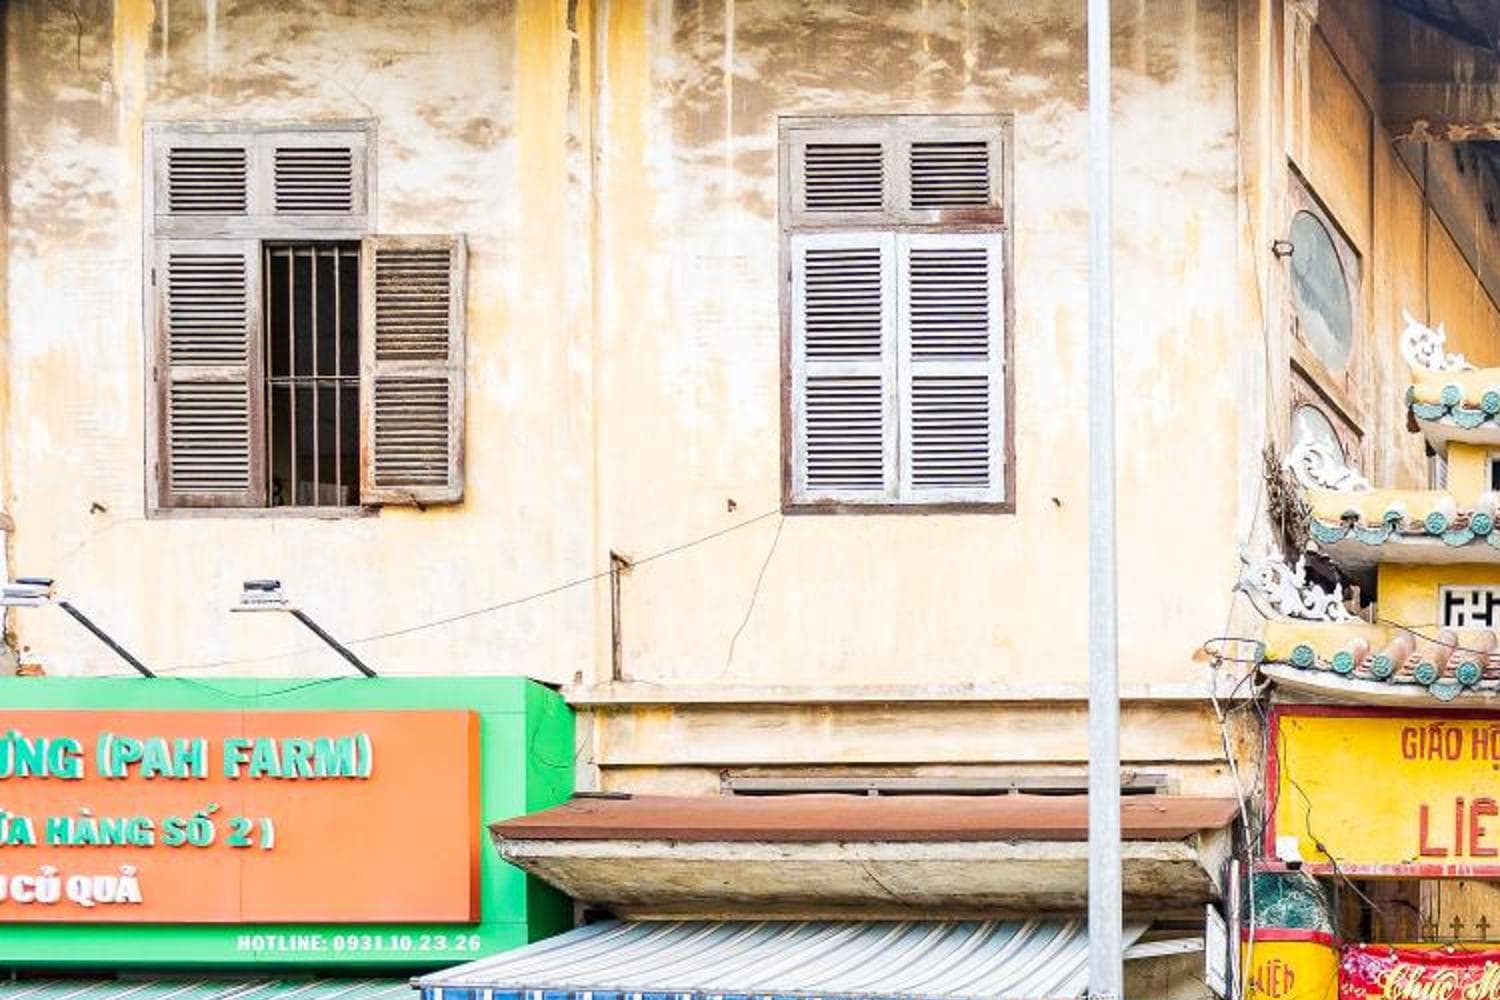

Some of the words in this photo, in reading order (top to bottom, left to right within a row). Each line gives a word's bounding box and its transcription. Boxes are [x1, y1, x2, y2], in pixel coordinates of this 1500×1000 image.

[97, 730, 208, 779] (PAH
[222, 732, 373, 779] FARM)
[1402, 722, 1463, 761] GIÁO
[45, 806, 155, 848] HÀNG
[160, 801, 220, 848] SỐ
[10, 864, 62, 904] CỦ
[66, 863, 144, 908] QUẢ
[237, 934, 327, 951] HOTLINE:
